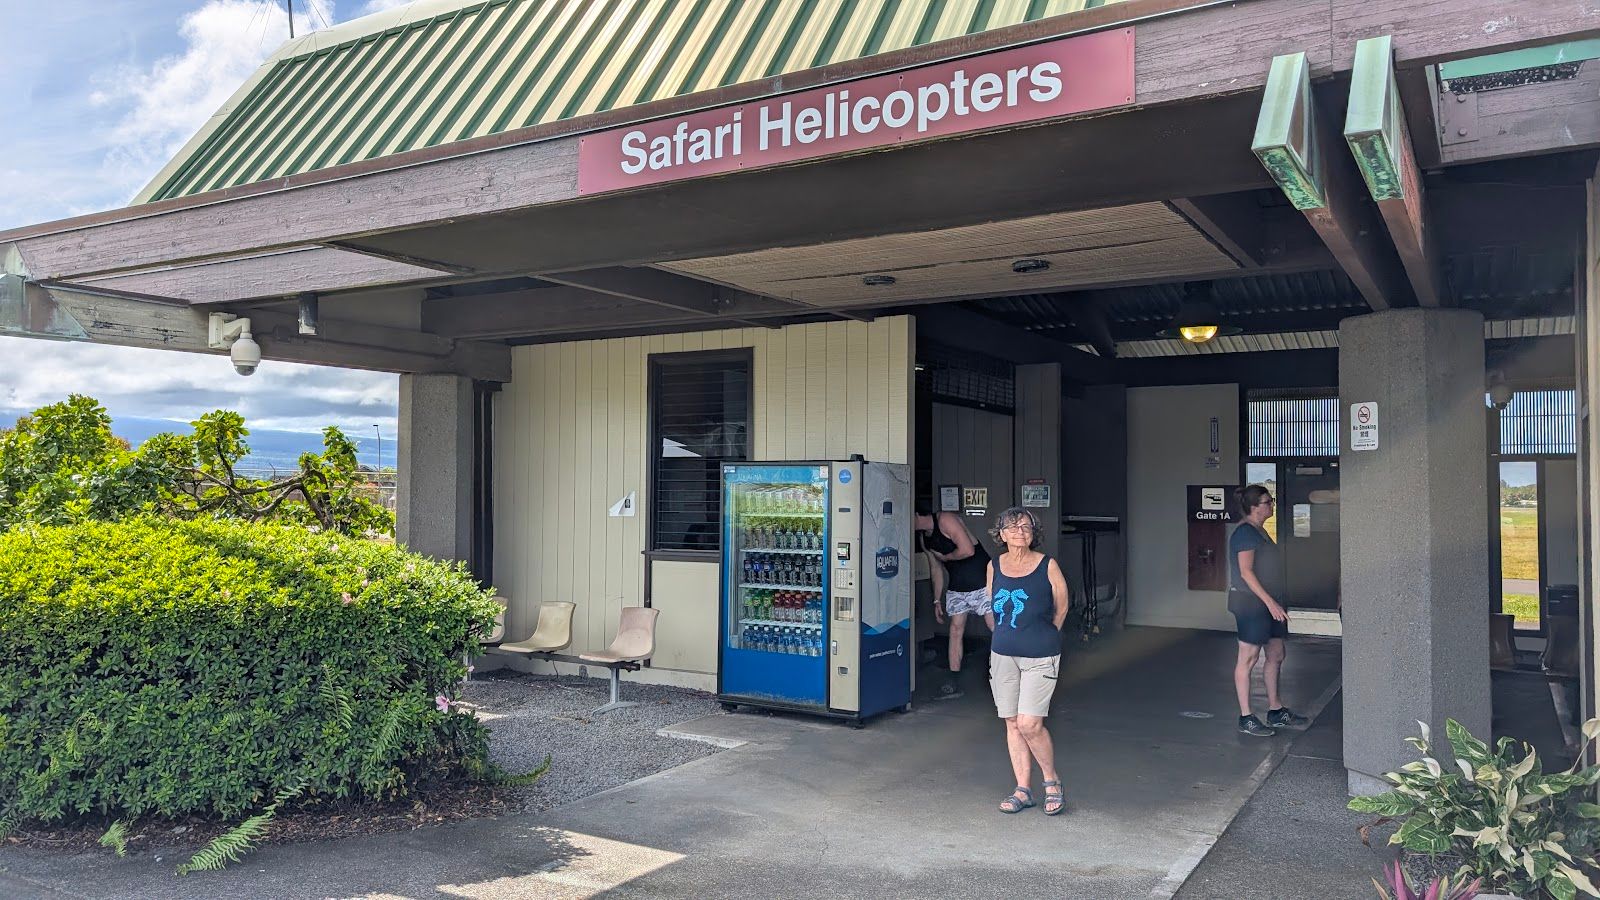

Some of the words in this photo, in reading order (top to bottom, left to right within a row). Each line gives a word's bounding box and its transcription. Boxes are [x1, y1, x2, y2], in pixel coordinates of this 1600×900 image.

[620, 111, 742, 175] Safari
[759, 61, 1063, 151] Helicopters
[965, 490, 986, 505] EXIT
[1196, 511, 1217, 520] Gate
[1219, 512, 1231, 520] 1A
